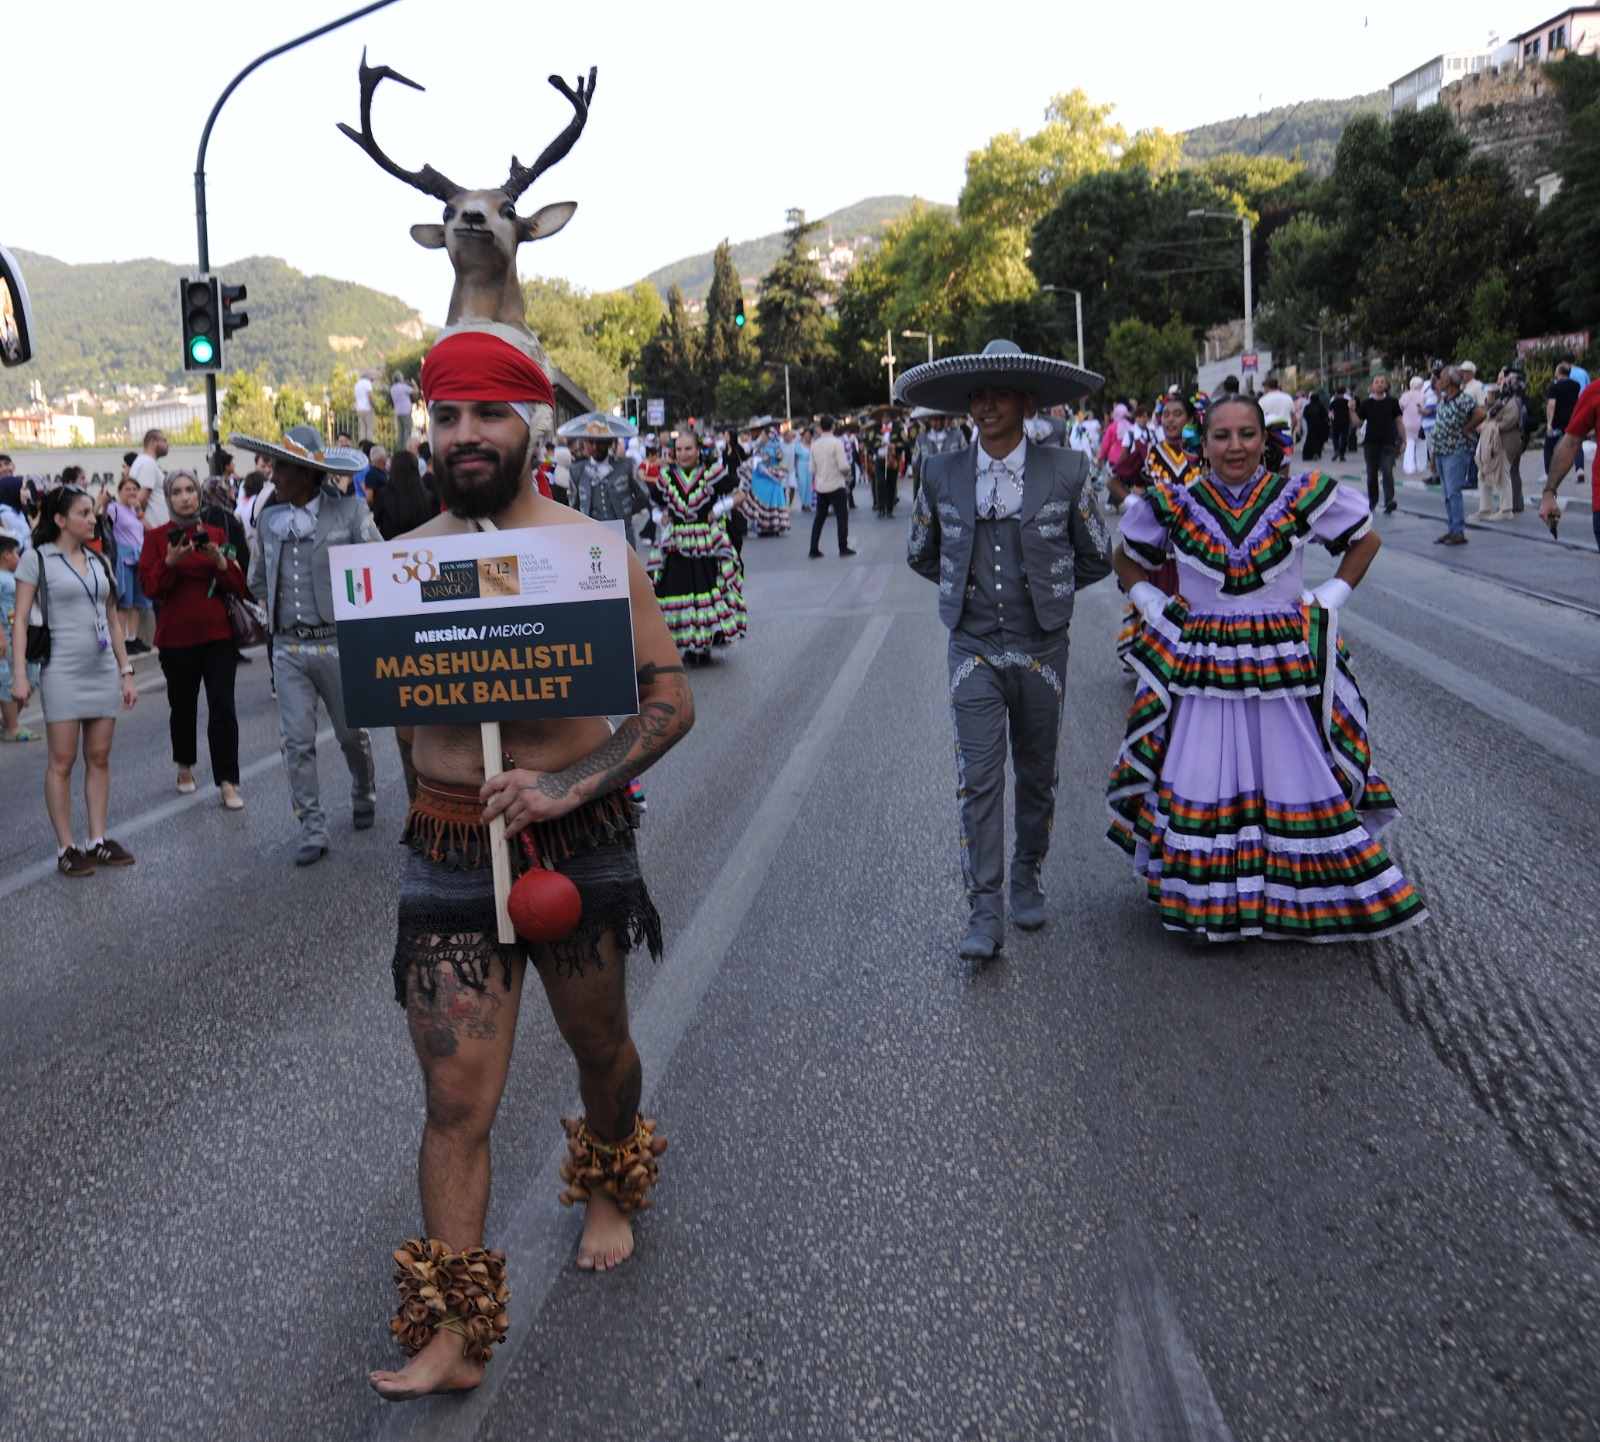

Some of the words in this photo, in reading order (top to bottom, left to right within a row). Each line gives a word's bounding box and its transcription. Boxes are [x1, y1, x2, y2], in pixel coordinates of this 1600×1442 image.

[392, 549, 443, 585] 38.
[488, 622, 545, 638] MEXICO
[375, 643, 593, 679] MASEHUALISTLI
[399, 682, 469, 708] FOLK
[472, 676, 573, 704] BALLET
